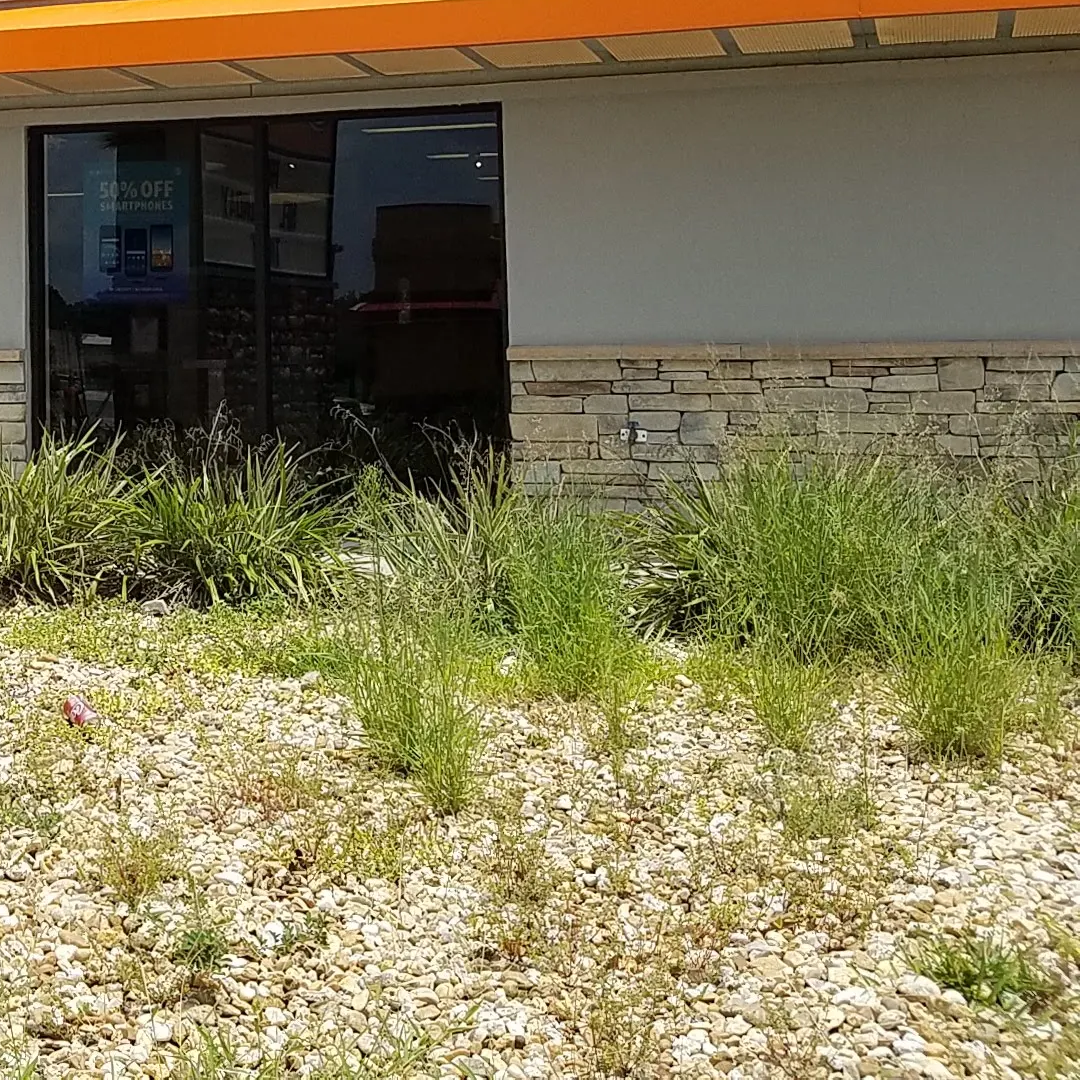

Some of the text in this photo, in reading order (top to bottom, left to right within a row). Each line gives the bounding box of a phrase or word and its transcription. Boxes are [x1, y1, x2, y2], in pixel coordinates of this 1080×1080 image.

[99, 180, 174, 199] 50% OFF
[100, 201, 173, 212] SMARTPHONES
